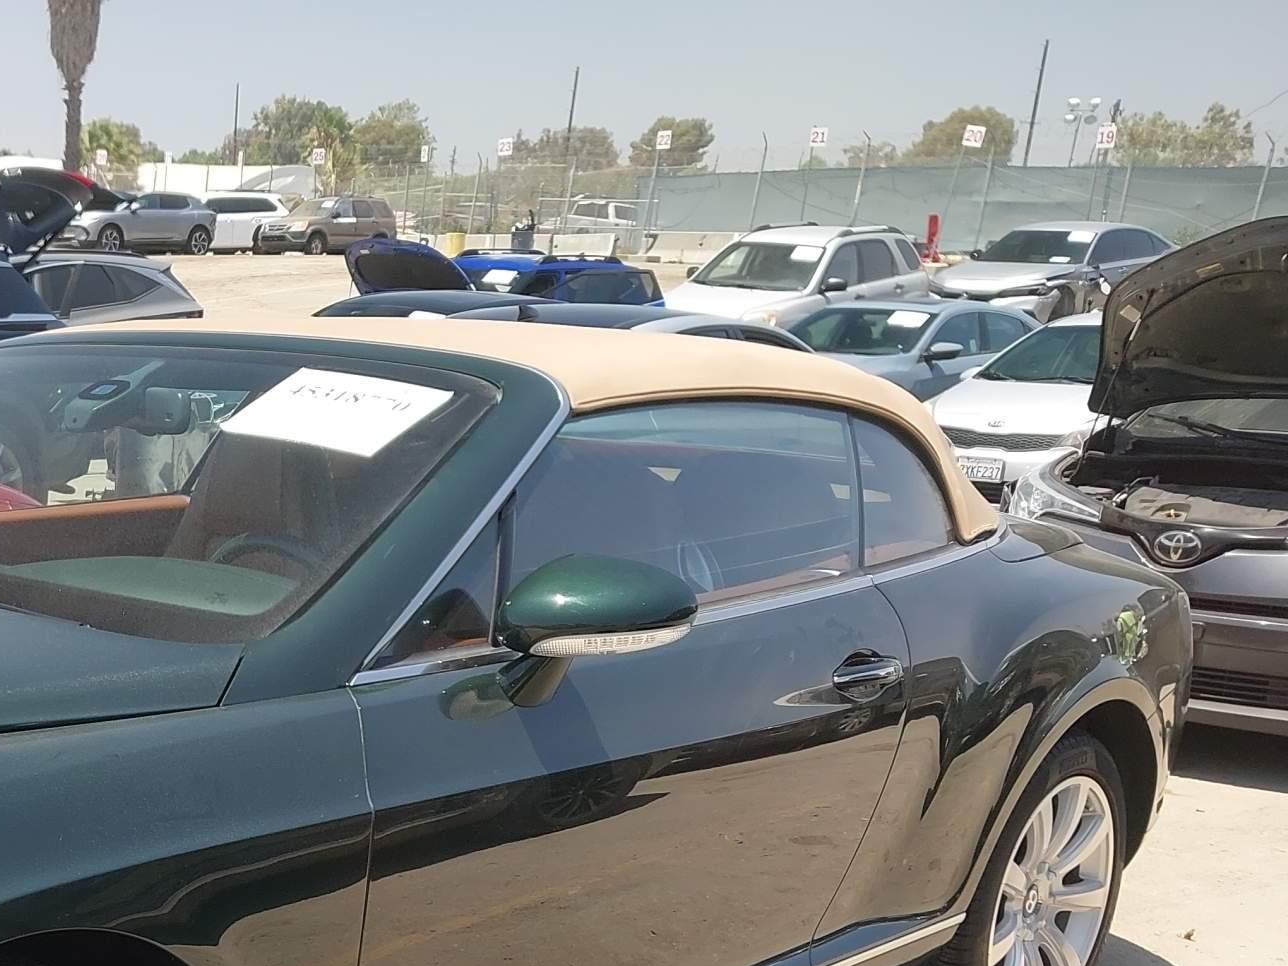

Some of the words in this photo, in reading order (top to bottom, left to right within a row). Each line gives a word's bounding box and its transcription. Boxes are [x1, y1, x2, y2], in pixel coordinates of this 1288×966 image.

[811, 131, 824, 143] 21
[964, 129, 984, 143] 20
[1098, 130, 1114, 144] 19
[499, 141, 511, 152] 23
[314, 151, 324, 161] 25
